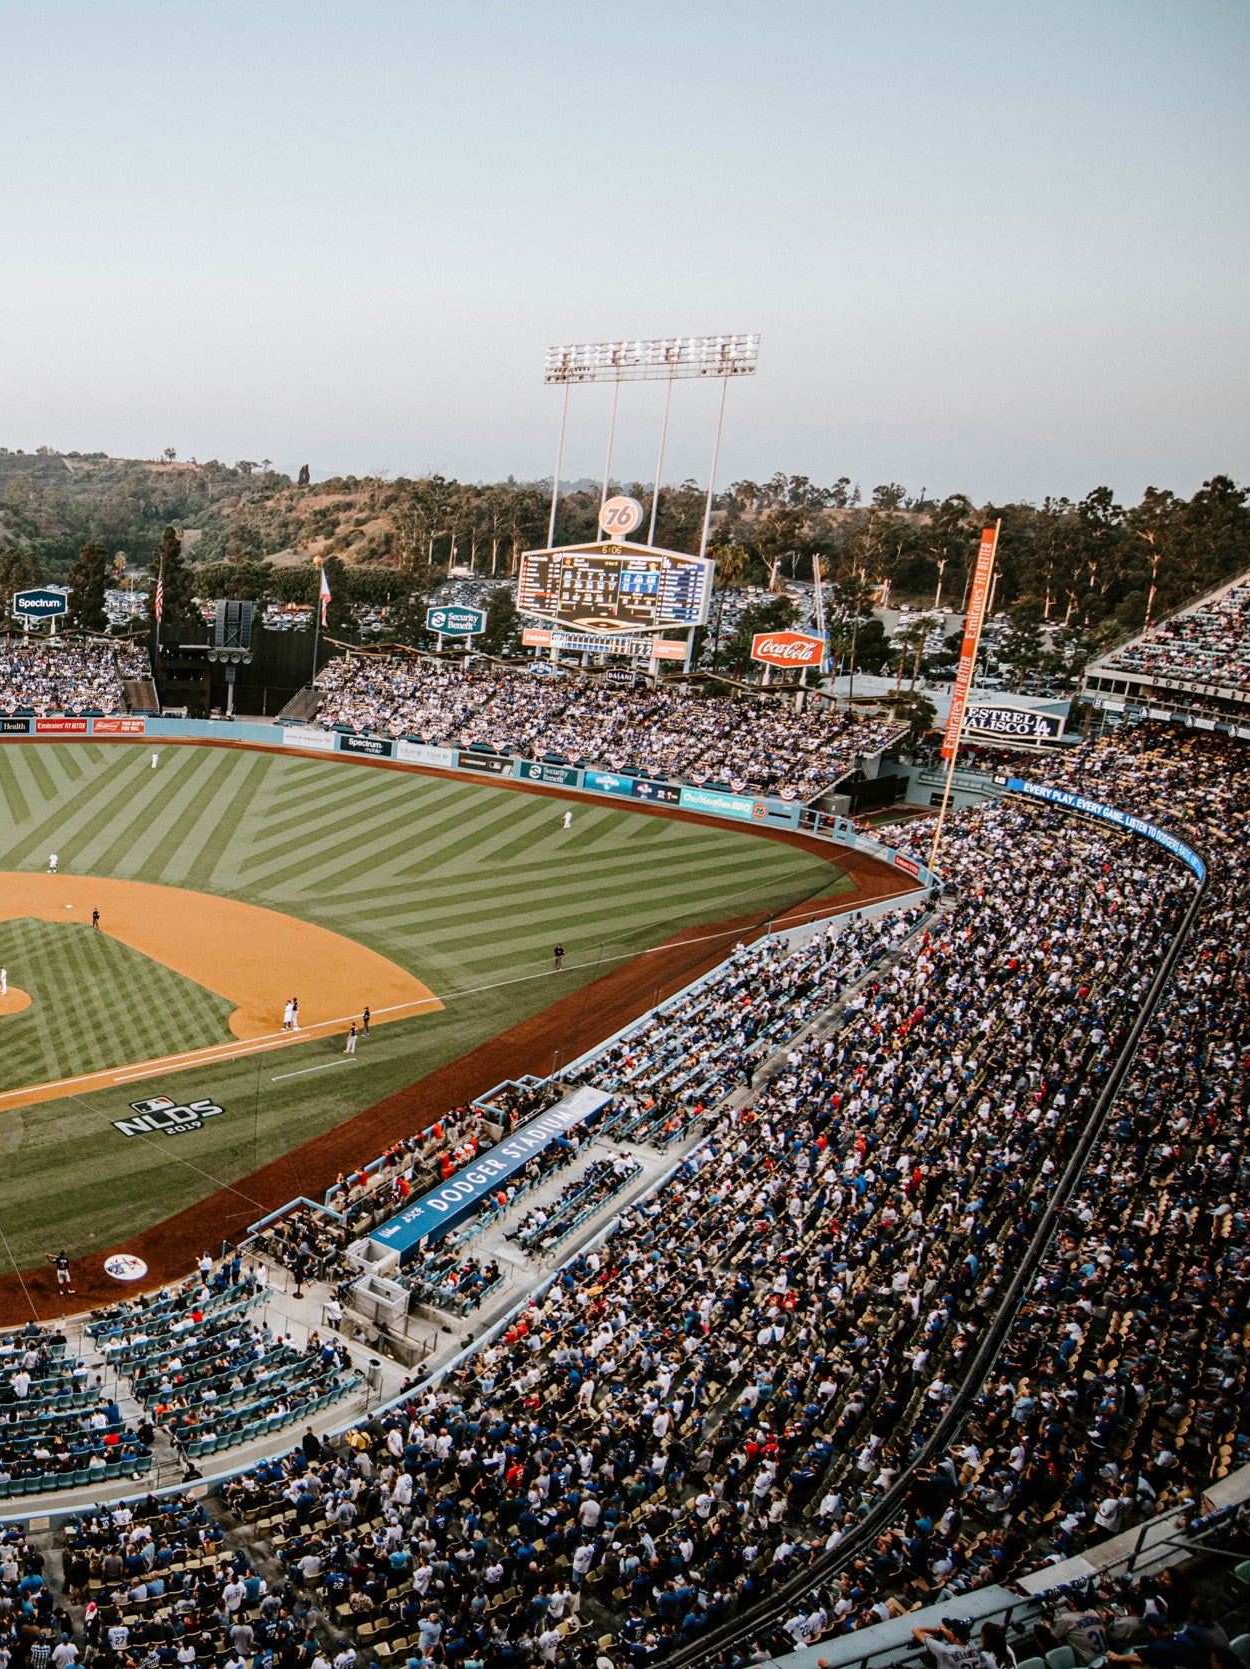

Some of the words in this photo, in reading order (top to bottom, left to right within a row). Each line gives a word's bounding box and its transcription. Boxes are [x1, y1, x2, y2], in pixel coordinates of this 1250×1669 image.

[606, 505, 631, 526] 76
[979, 543, 993, 569] BETTER
[974, 571, 988, 585] FLY
[19, 599, 59, 608] Spectrum
[448, 612, 478, 623] Security
[966, 586, 984, 639] Emirates
[448, 621, 473, 630] Benefit
[639, 645, 644, 654] 2
[646, 646, 651, 654] 2
[757, 638, 818, 661] Coca-Cola
[608, 672, 632, 681] DASANI
[956, 657, 972, 683] BETTER
[954, 684, 967, 698] FLY
[1153, 678, 1219, 696] DODGER
[3, 722, 26, 730] Health
[945, 699, 963, 749] Emirates
[348, 738, 381, 749] Spectrum
[543, 767, 569, 778] Security
[543, 773, 564, 783] Benefit
[731, 801, 750, 812] BBQ
[754, 807, 765, 815] 76
[1023, 783, 1052, 799] EVERY
[1052, 791, 1075, 807] PLAY.
[1076, 799, 1103, 814] EVERY
[1126, 815, 1149, 834] LISTEN
[1149, 825, 1157, 837] TO
[114, 1100, 223, 1136] NLDS
[165, 1121, 201, 1135] 2019
[426, 1159, 508, 1211] DODGER
[502, 1110, 575, 1158] STADIUM
[800, 1625, 810, 1637] 22
[115, 1636, 125, 1644] 27
